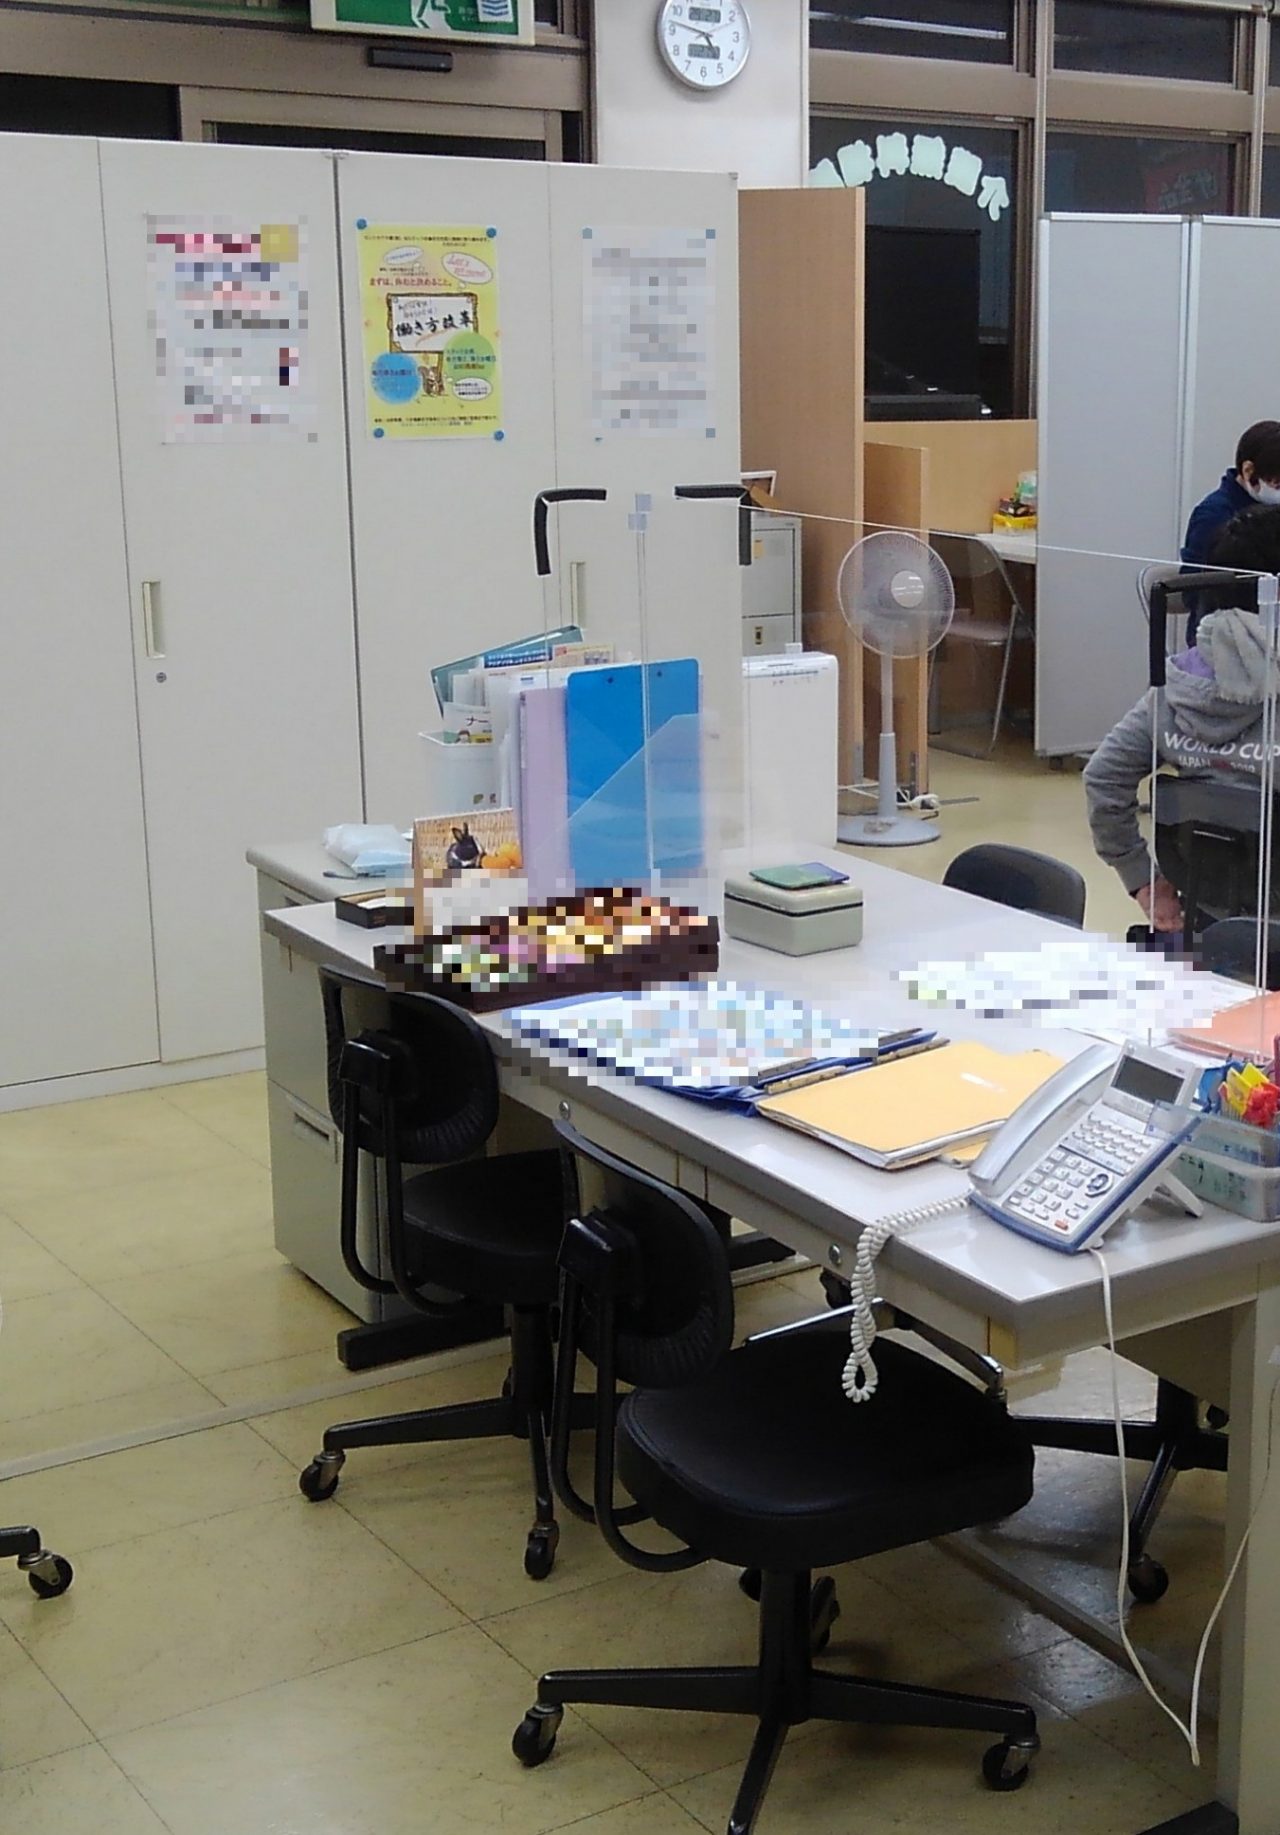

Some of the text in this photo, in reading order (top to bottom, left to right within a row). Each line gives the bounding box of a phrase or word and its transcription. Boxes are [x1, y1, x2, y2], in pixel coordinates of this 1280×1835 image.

[672, 5, 683, 17] 10
[728, 10, 736, 22] 2
[668, 24, 676, 36] 9
[732, 31, 740, 43] 3
[673, 45, 680, 56] 8
[728, 50, 735, 61] 4
[684, 60, 691, 71] 7
[716, 63, 724, 74] 5
[700, 66, 708, 78] 6
[395, 310, 474, 337] 働き方改革
[1164, 732, 1236, 756] WORLD
[1178, 755, 1212, 769] JAPAN
